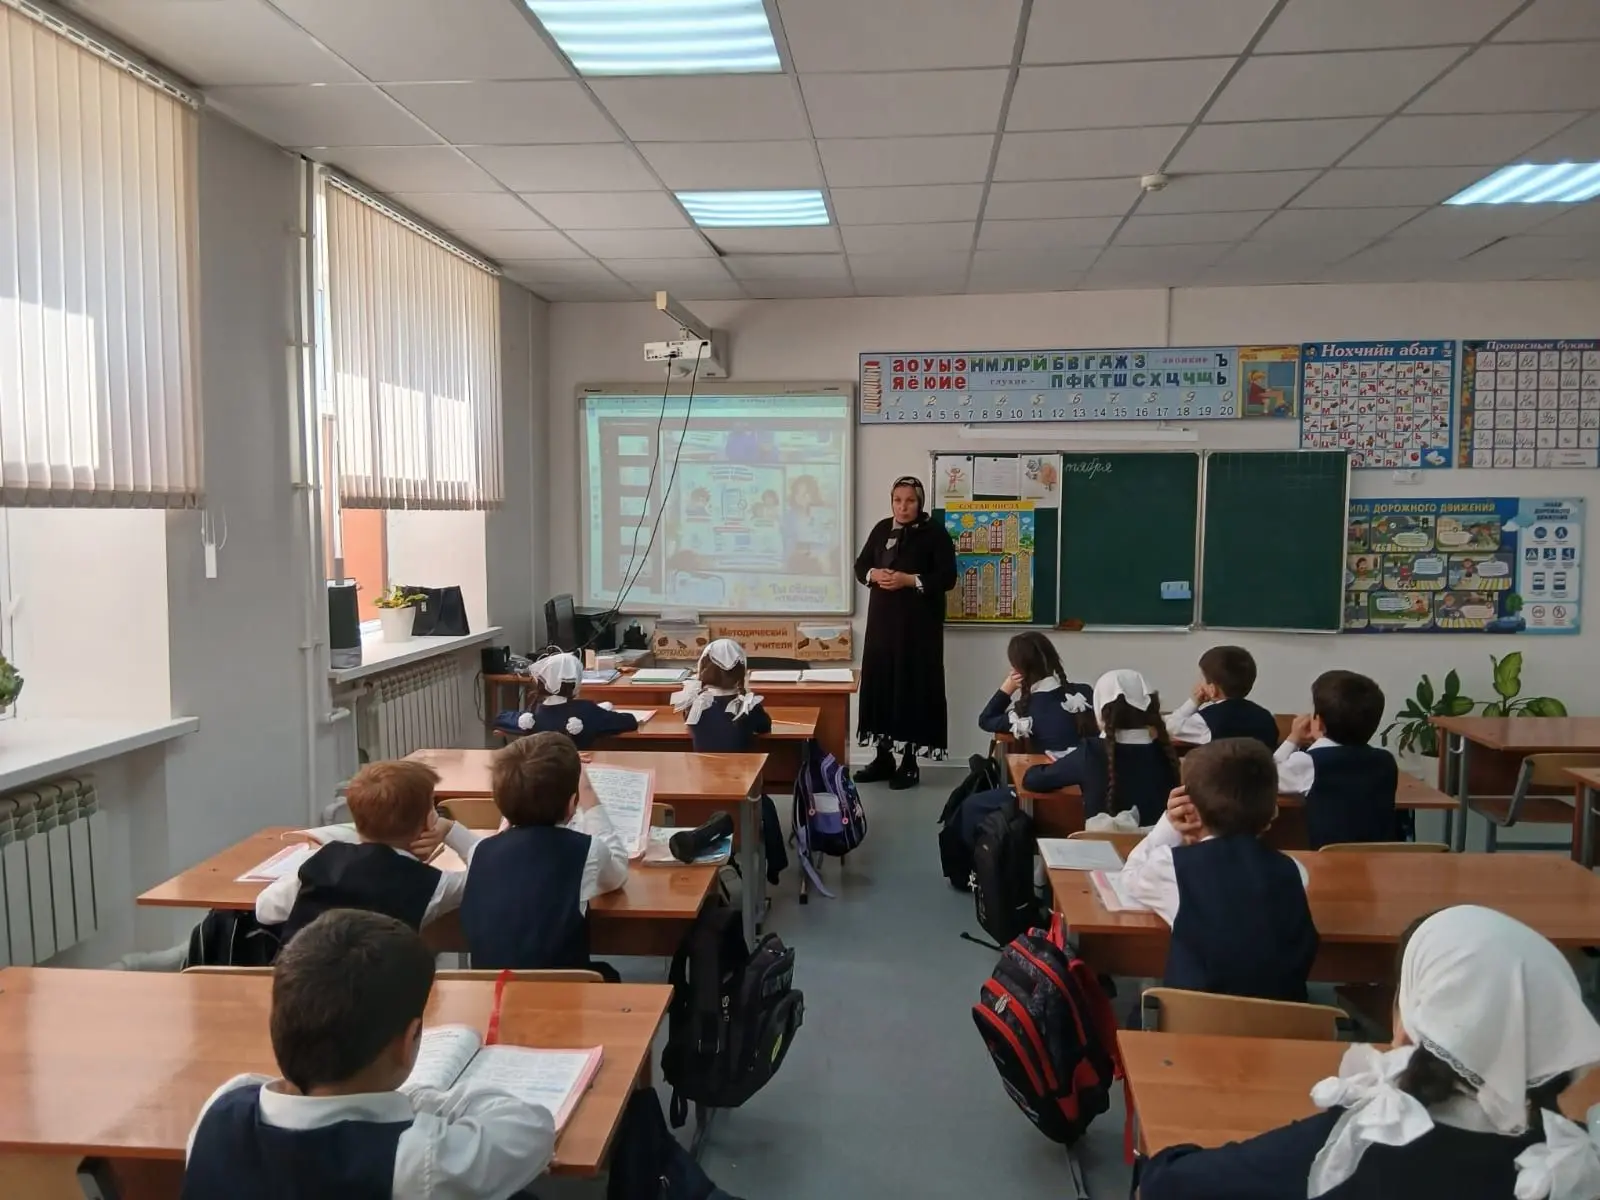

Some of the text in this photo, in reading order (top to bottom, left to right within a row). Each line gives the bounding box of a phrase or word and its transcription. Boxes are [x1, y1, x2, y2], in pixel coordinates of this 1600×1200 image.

[1321, 342, 1437, 357] Нохчийн абат
[926, 396, 936, 407] 2
[963, 394, 972, 406] 3
[1032, 394, 1043, 406] 5
[1072, 393, 1082, 404] 6
[1185, 391, 1196, 403] 9
[1222, 391, 1233, 402] 0
[898, 411, 904, 420] 2
[912, 411, 918, 419] 3
[926, 411, 932, 419] 4
[940, 411, 946, 419] 5
[954, 410, 960, 419] 6
[968, 410, 974, 419] 7
[982, 410, 988, 419] 8
[996, 410, 1002, 419] 9
[1011, 409, 1023, 418] 10
[1032, 409, 1043, 418] 11
[1052, 409, 1064, 418] 12
[1073, 408, 1086, 417] 13
[1094, 408, 1106, 417] 14
[1114, 408, 1127, 417] 15
[1136, 408, 1148, 417] 16
[1157, 408, 1168, 416] 17
[1177, 407, 1190, 416] 18
[1199, 407, 1211, 416] 19
[1220, 407, 1234, 416] 20
[1373, 503, 1437, 514] ДОРОЖНОГО
[1440, 502, 1496, 513] ДВИЖЕНИЯ
[719, 627, 788, 637] Методический
[754, 642, 793, 651] учителя
